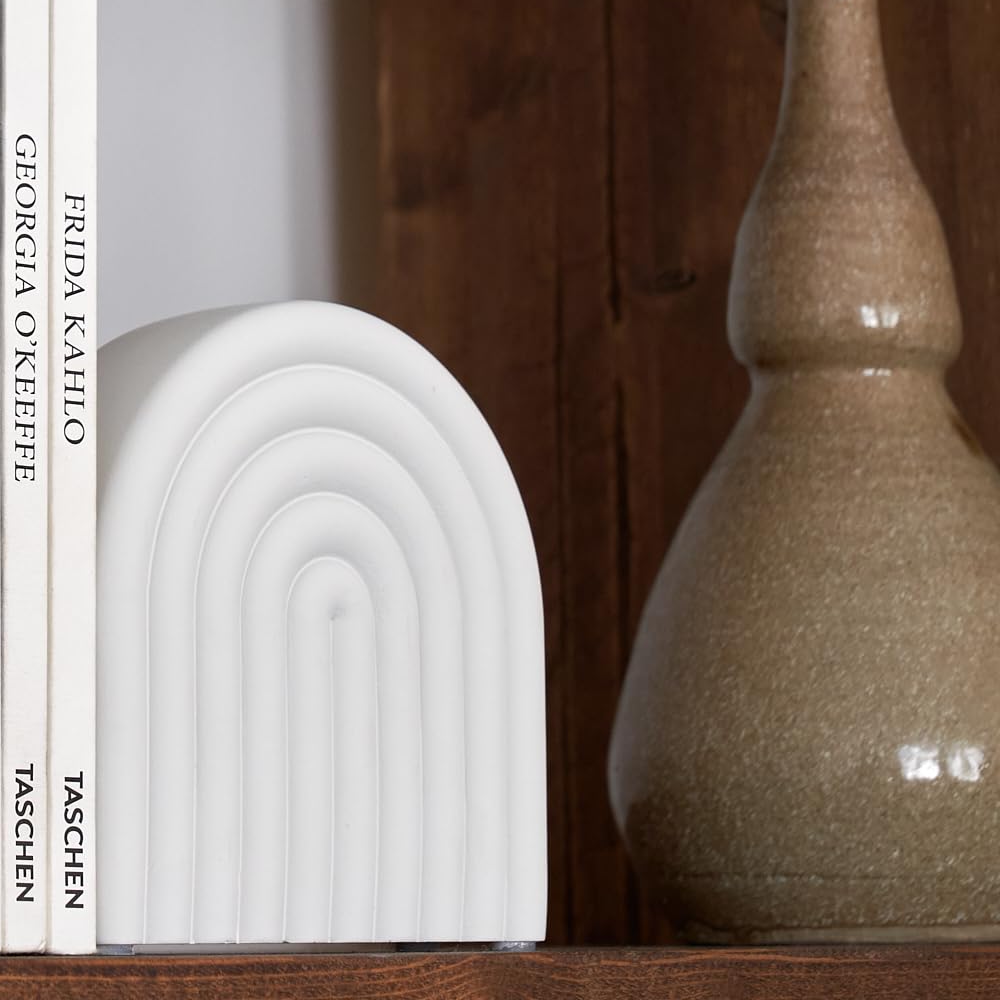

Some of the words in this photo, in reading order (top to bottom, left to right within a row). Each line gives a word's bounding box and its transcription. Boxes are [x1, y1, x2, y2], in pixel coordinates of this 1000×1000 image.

[14, 133, 37, 298] GEORGIA
[64, 191, 86, 301] FRIDA
[14, 310, 38, 482] O'KEEFFE
[63, 312, 86, 445] KAHLO
[14, 762, 35, 902] TASCHEN
[63, 770, 84, 909] TASCHEN
